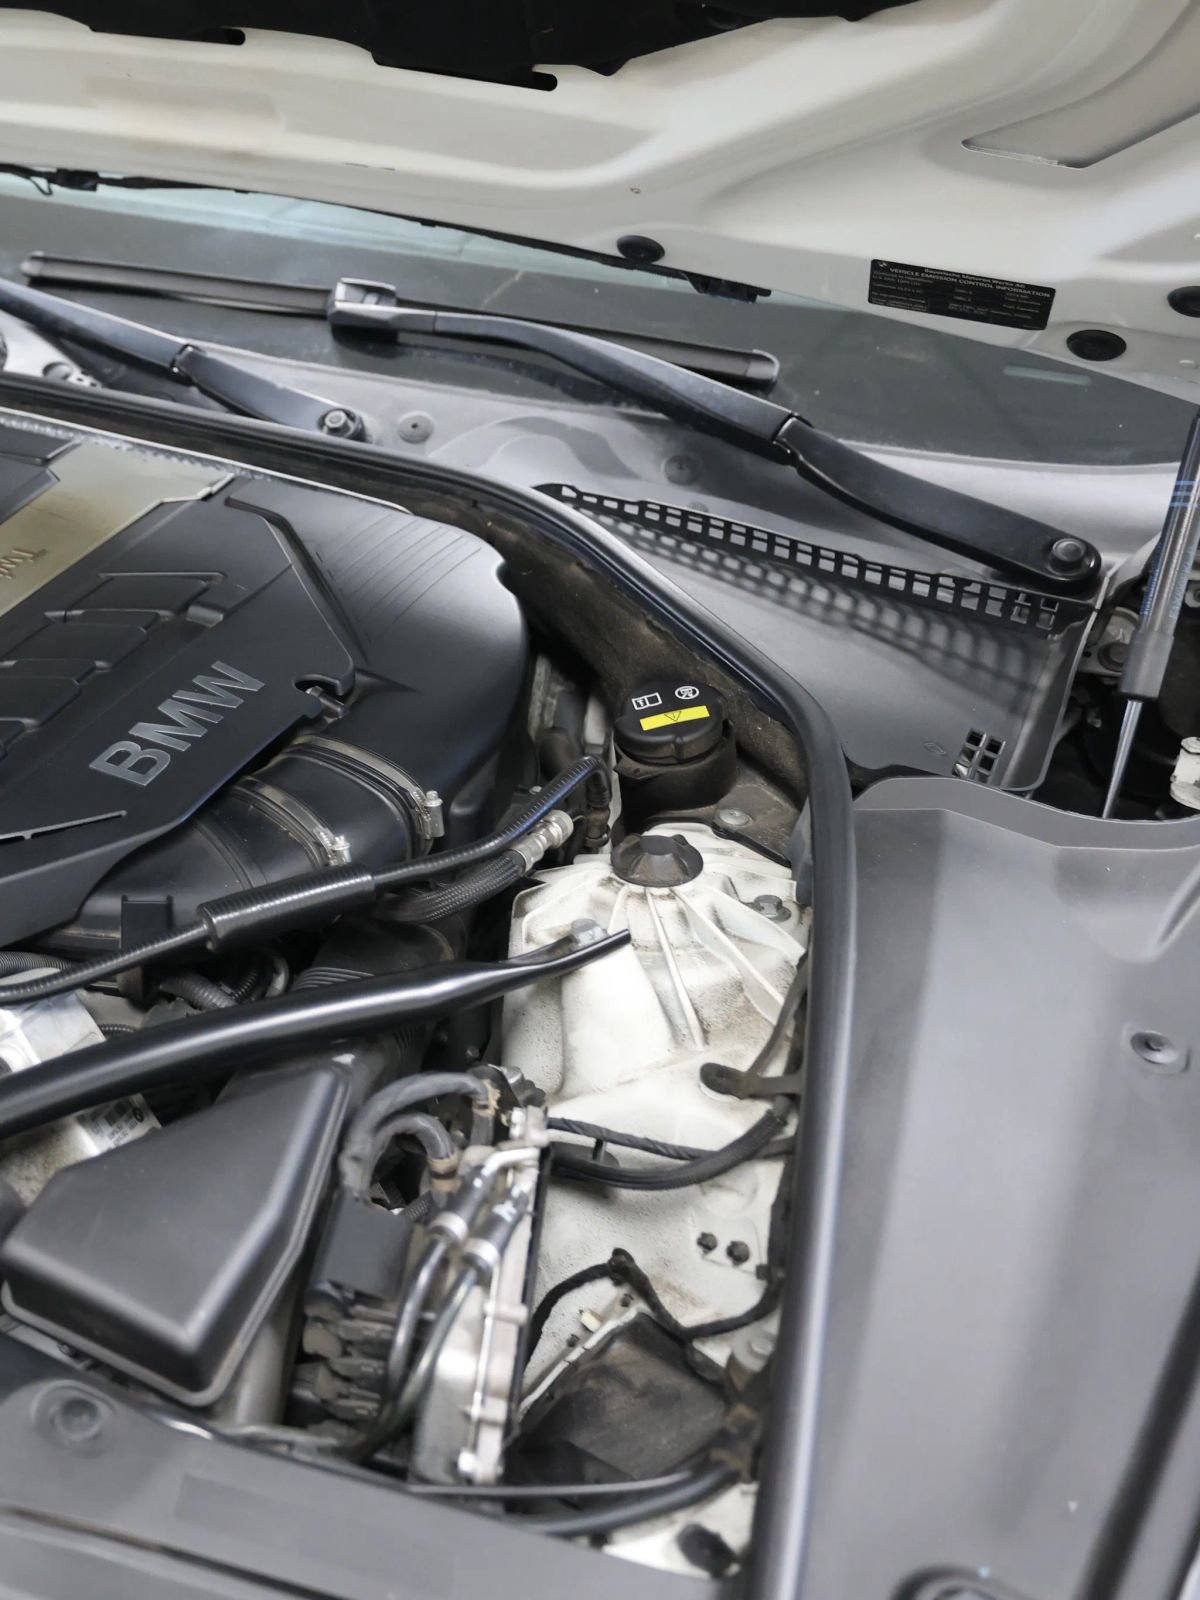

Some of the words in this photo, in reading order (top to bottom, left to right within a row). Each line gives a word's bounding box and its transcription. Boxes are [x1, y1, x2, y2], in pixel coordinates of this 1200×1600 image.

[889, 267, 921, 277] VEHICLE
[921, 272, 958, 283] EMISSION
[959, 279, 994, 289] CONTROL
[995, 284, 1050, 298] INFORMATION
[89, 660, 265, 787] BMW
